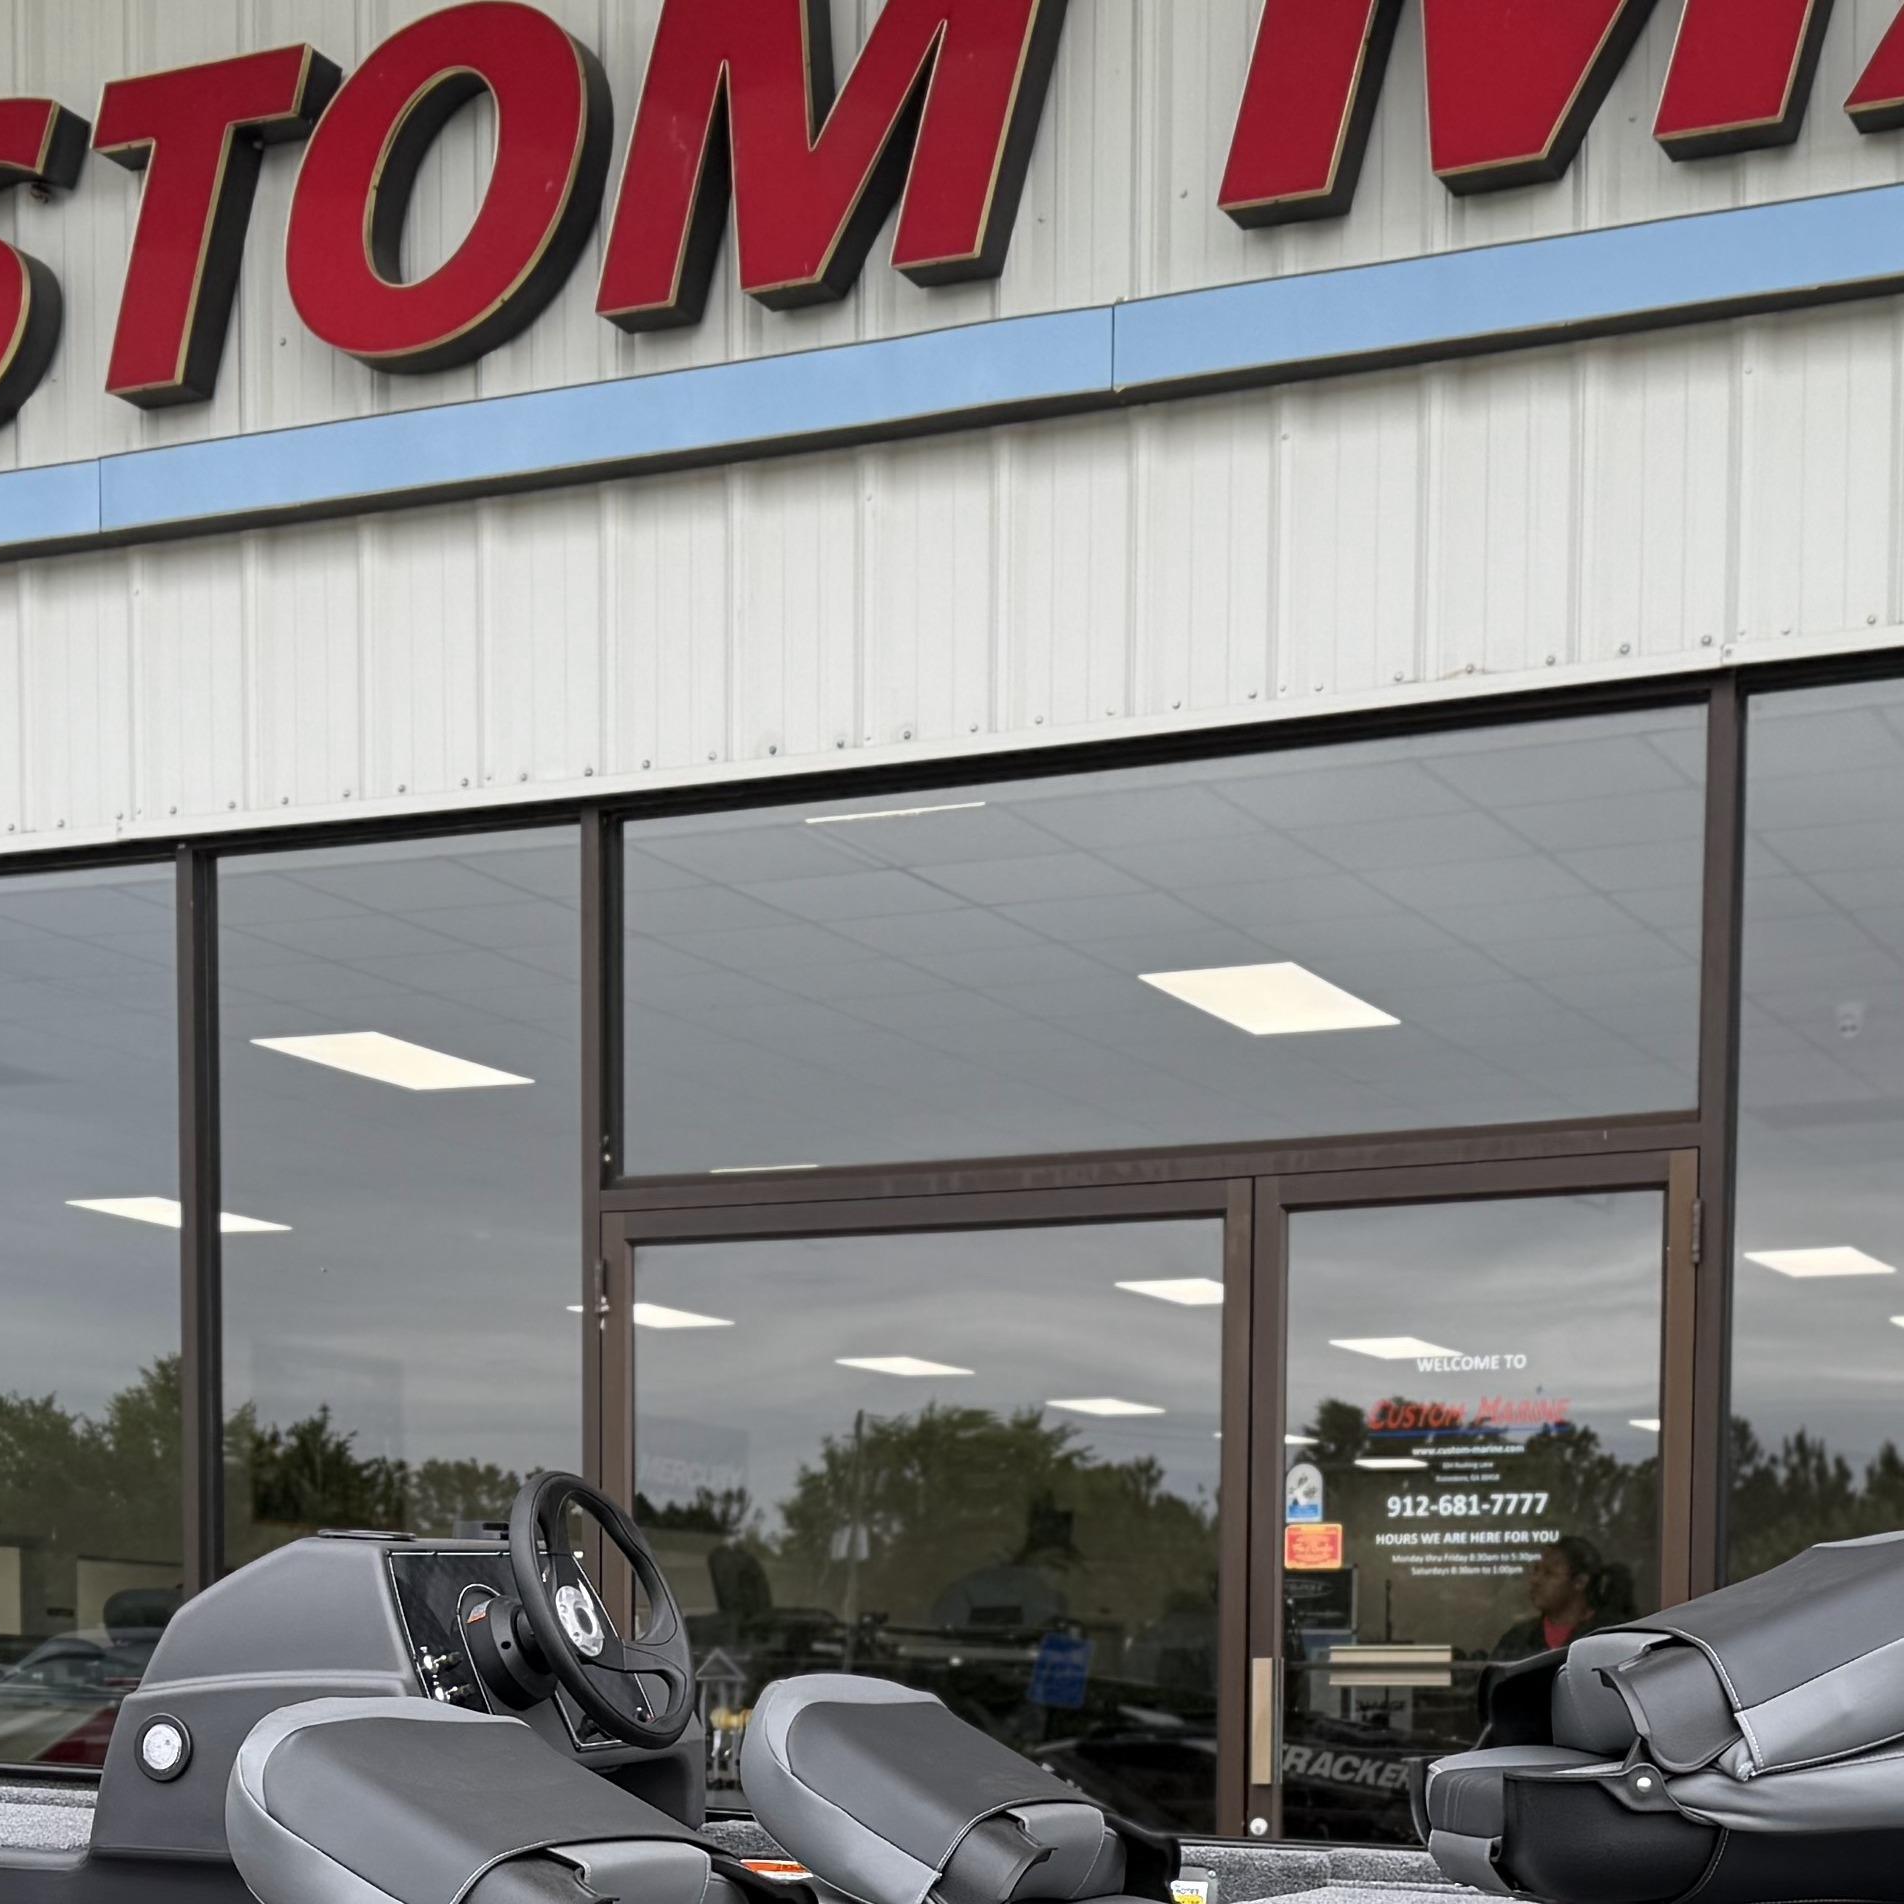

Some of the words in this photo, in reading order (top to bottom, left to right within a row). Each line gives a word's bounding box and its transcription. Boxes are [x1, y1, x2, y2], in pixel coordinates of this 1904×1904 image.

[1417, 1355, 1500, 1372] WELCOME
[1504, 1354, 1527, 1369] TO
[1369, 1398, 1466, 1432] CUSTOM
[1412, 1445, 1525, 1456] www.custom-marine.com
[1387, 1493, 1549, 1518] 912-681-7777
[1375, 1533, 1418, 1545] HOURS
[1421, 1533, 1440, 1544] WE
[1443, 1532, 1467, 1544] ARE
[1470, 1531, 1501, 1543] HERE
[1504, 1530, 1529, 1543] FOR
[1532, 1530, 1560, 1543] YOU
[1283, 1743, 1409, 1790] RACKE
